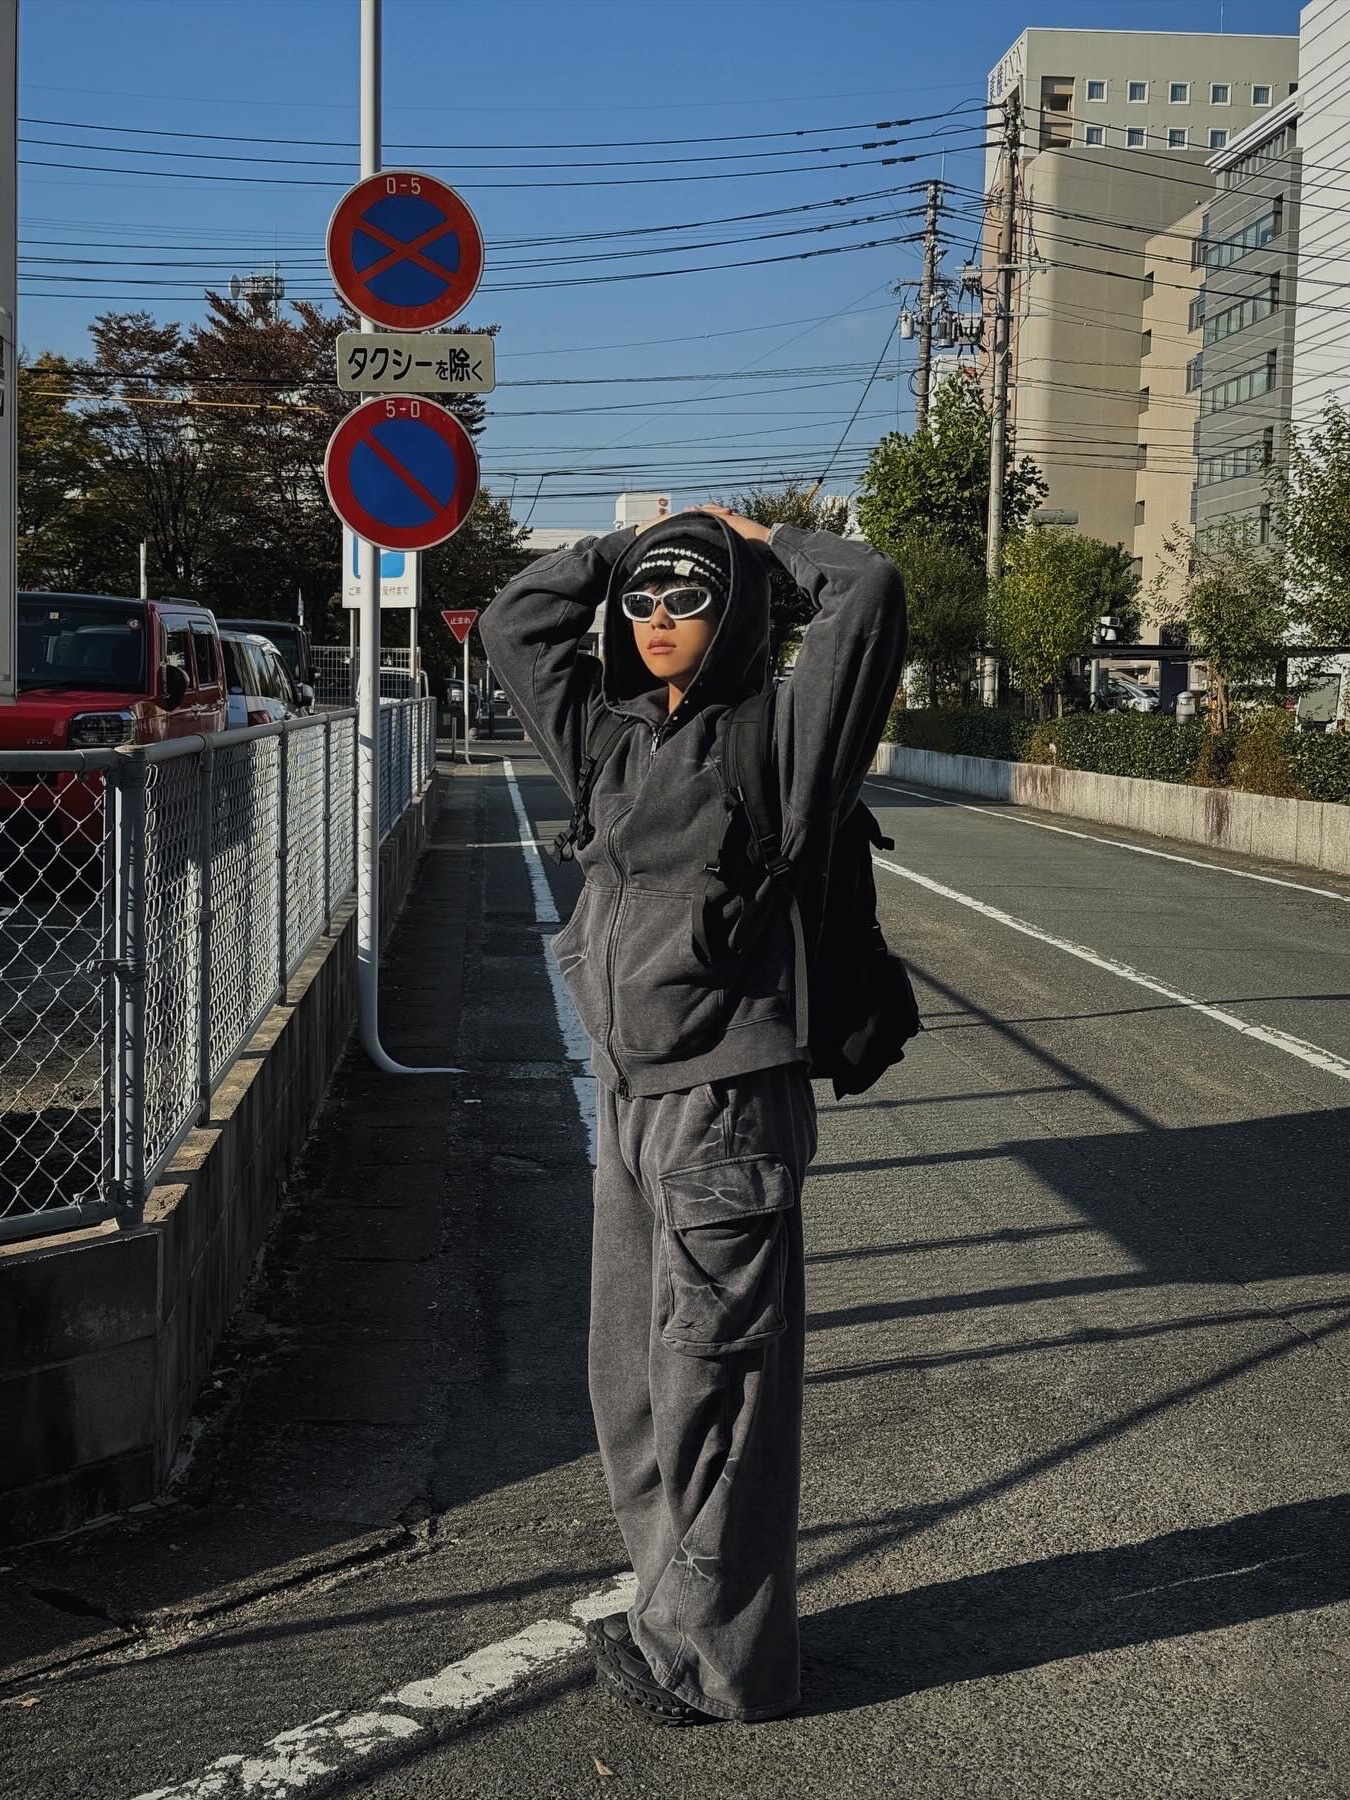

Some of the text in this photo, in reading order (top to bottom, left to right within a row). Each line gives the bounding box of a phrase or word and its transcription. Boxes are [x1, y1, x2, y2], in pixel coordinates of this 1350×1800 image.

[386, 177, 421, 195] 0-5
[348, 347, 483, 382] タクシーを除く
[385, 400, 420, 418] 5-0
[450, 616, 471, 625] 止まれ
